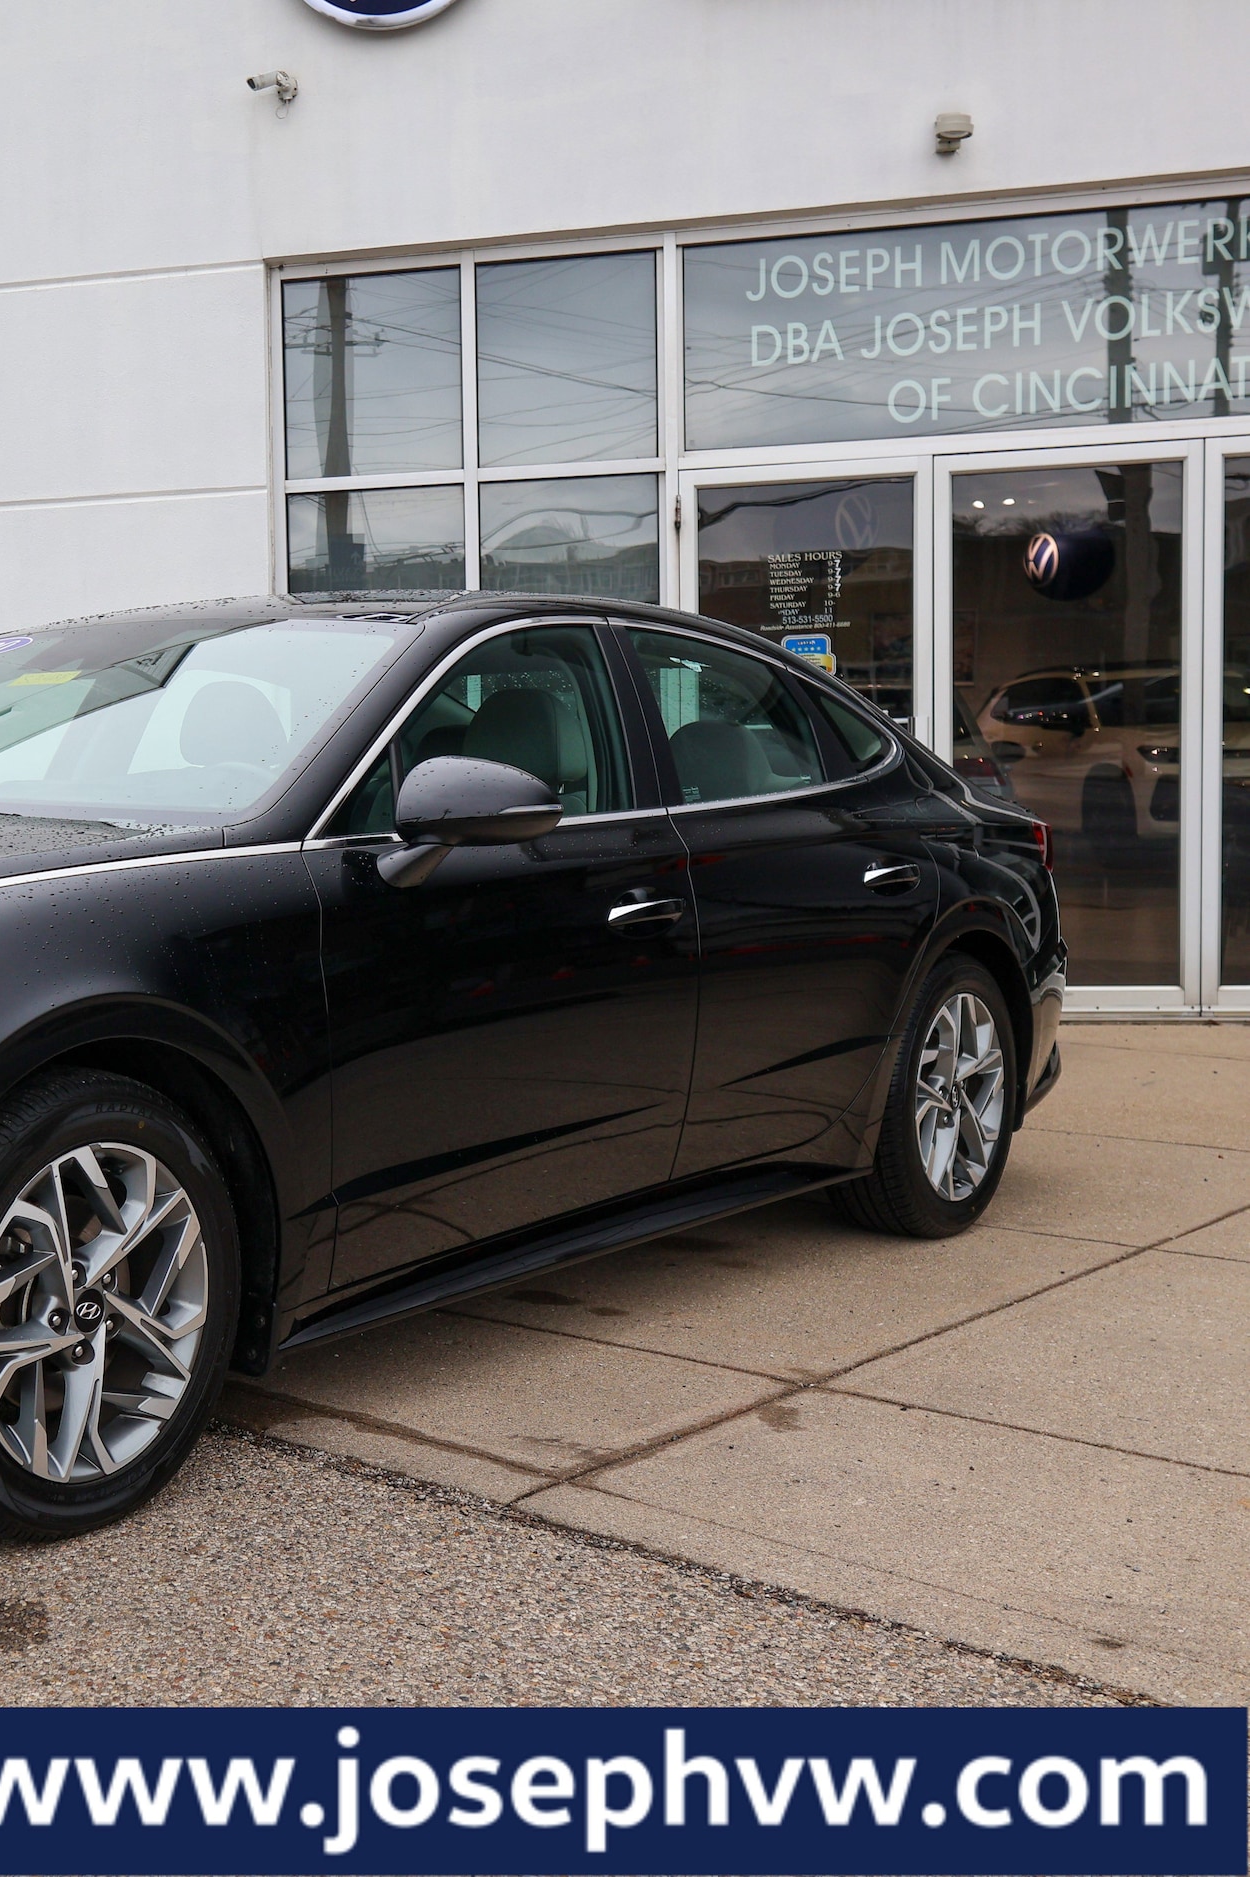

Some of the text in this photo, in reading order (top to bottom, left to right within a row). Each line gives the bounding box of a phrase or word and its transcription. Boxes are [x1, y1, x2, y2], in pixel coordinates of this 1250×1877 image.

[746, 244, 923, 302] JOSEPH
[751, 319, 845, 367] DBA
[861, 302, 1041, 359] JOSEPH
[887, 377, 952, 424] OF
[767, 550, 843, 564] SALES HOURS
[769, 562, 800, 570] MONDAY
[769, 570, 803, 578] TUESDAY
[769, 577, 814, 586] WEDNESDAY
[769, 585, 808, 593] THURSDAY
[769, 594, 795, 602] FRIDAY
[769, 601, 807, 610] SATURDAY
[782, 614, 834, 625] 513-531-5500
